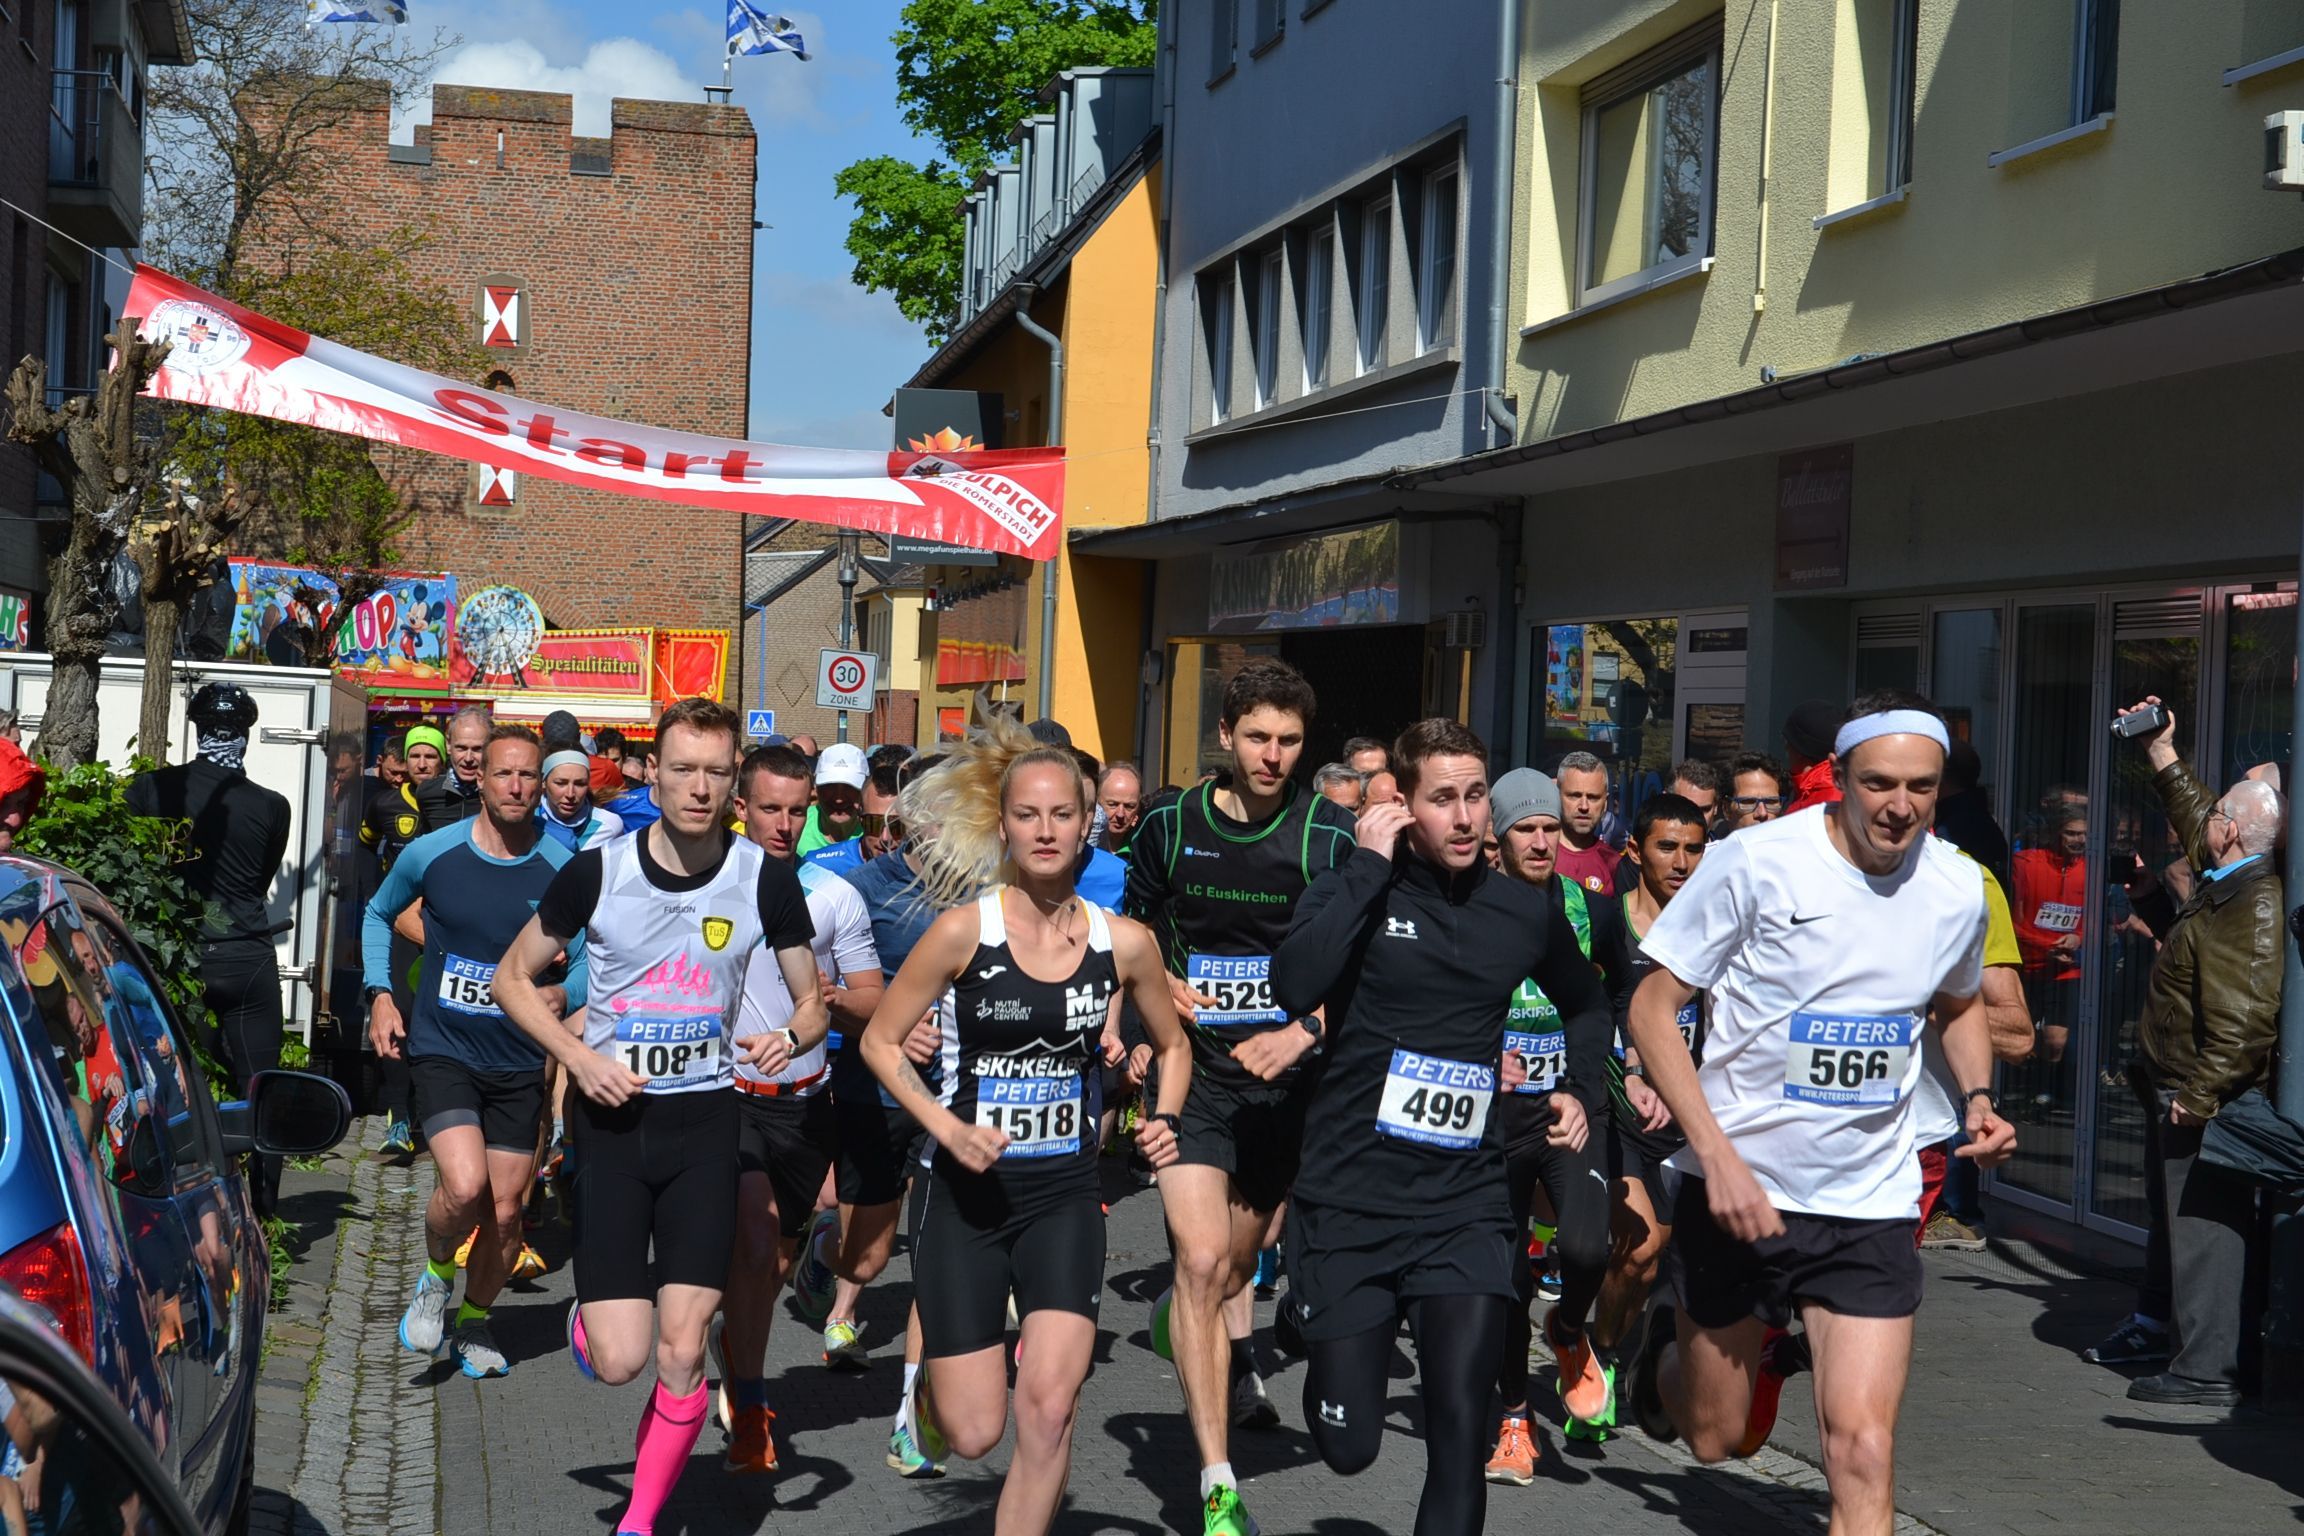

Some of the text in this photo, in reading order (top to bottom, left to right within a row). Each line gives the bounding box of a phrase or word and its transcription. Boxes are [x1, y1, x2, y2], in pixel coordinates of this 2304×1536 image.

[426, 389, 764, 484] Start
[940, 479, 960, 488] DIE
[529, 653, 638, 675] Spezialitäten
[836, 665, 858, 684] 30
[830, 694, 859, 706] ZONE
[815, 851, 838, 859] CRAFT
[1186, 883, 1288, 903] LC Euskirchen
[664, 906, 696, 914] FUSION
[708, 926, 726, 937] TuS
[454, 961, 495, 980] PETE
[1200, 960, 1270, 977] PETERS
[448, 976, 496, 1007] 153
[1196, 980, 1278, 1011] 1529
[630, 1020, 710, 1041] PETERS
[1806, 1019, 1900, 1044] PETERS
[1505, 1034, 1567, 1052] PETERS
[624, 1041, 709, 1077] 1081
[1809, 1047, 1890, 1088] 566
[1398, 1054, 1493, 1089] PETERS
[993, 1079, 1072, 1102] PETERS
[1401, 1087, 1475, 1131] 499
[986, 1102, 1075, 1142] 1518
